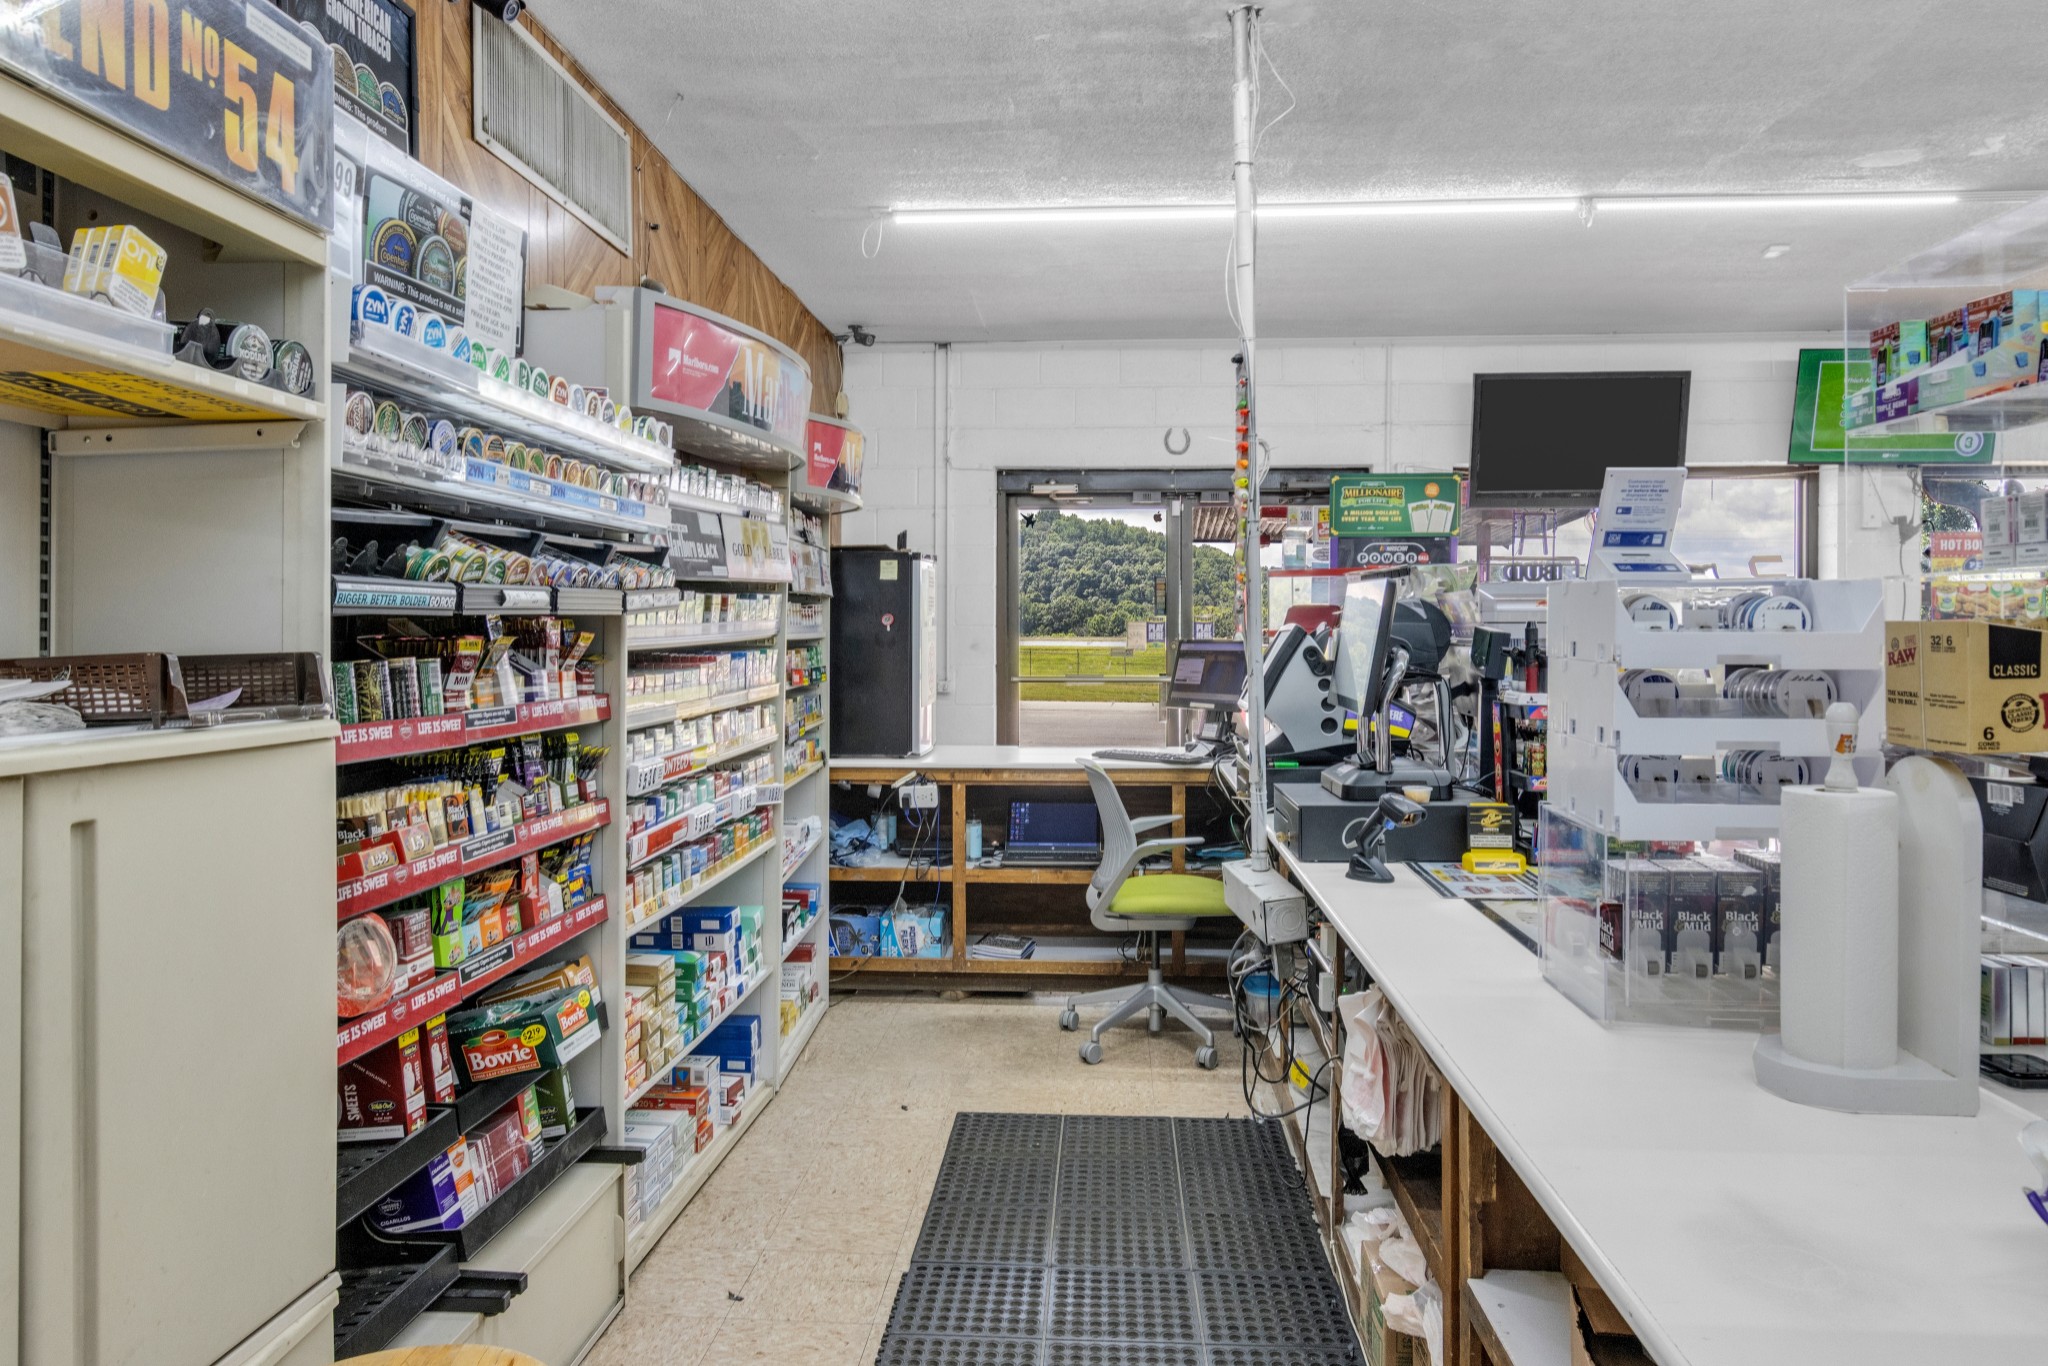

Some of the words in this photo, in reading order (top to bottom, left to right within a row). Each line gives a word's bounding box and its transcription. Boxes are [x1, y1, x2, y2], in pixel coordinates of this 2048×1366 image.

[356, 16, 391, 62] TOBACCO
[224, 38, 299, 196] 54
[366, 113, 388, 136] product
[374, 271, 407, 294] WARNING:
[407, 284, 419, 299] This
[419, 289, 438, 306] product
[442, 300, 452, 311] not
[366, 297, 385, 313] ZYN
[426, 327, 442, 344] ZYN
[239, 348, 268, 364] KODIAK
[286, 350, 302, 392] KODIAK
[535, 375, 547, 389] ZYN
[556, 386, 567, 398] ZYN
[1877, 402, 1892, 413] TRIPLE
[1893, 399, 1908, 411] BERRY
[1964, 436, 1973, 449] 3
[468, 464, 484, 480] ZYN
[553, 486, 566, 499] ZYN
[1344, 487, 1404, 499] MILLIONAIRE
[1300, 510, 1312, 519] 2001
[696, 543, 719, 559] BLACK
[732, 543, 753, 557] GOLD
[1940, 539, 1963, 551] HOT
[337, 592, 369, 605] BIGGER.
[371, 594, 398, 606] BETTER.
[400, 595, 429, 607] BOLDER.
[1149, 623, 1164, 632] PLAY
[1196, 623, 1212, 632] PLAY
[1149, 633, 1164, 642] HERE
[1930, 635, 1942, 646] 32
[1946, 635, 1953, 646] 6
[1887, 646, 1917, 666] RAW
[1993, 664, 2037, 677] CLASSIC
[1897, 690, 1919, 698] NATURAL
[1390, 710, 1404, 722] ERE
[2007, 711, 2034, 720] CLASSIC
[358, 727, 368, 742] IS
[368, 725, 394, 741] SWEET
[418, 721, 433, 735] LIFE
[433, 719, 441, 733] IS
[440, 718, 461, 731] SWEET
[1983, 726, 1994, 740] 6
[664, 754, 688, 775] ONTEGO
[337, 829, 366, 840] Black
[413, 862, 428, 875] LIFE
[428, 858, 437, 872] IS
[436, 849, 458, 867] SWEET
[353, 882, 363, 896] IS
[363, 872, 388, 893] SWEET
[576, 911, 586, 922] LIFE
[591, 899, 605, 914] SWEET
[1631, 910, 1664, 922] Black
[1678, 911, 1712, 922] Black
[1725, 911, 1759, 922] Black
[1600, 917, 1614, 936] lack
[1636, 920, 1664, 931] Mild
[1684, 921, 1712, 932] Mild
[529, 934, 540, 948] LIFE
[540, 930, 548, 942] IS
[547, 921, 562, 938] SWEET
[900, 928, 908, 950] FLEX
[908, 925, 919, 955] POWER
[412, 996, 427, 1011] LIFE
[427, 990, 436, 1004] IS
[435, 978, 457, 1001] SWEET
[561, 1006, 586, 1030] Bowie
[350, 1027, 361, 1041] IS
[361, 1011, 387, 1036] SWEET
[468, 1043, 533, 1072] Bowie
[344, 1084, 360, 1122] SWEETS
[380, 1215, 411, 1227] CIGARILLOS
